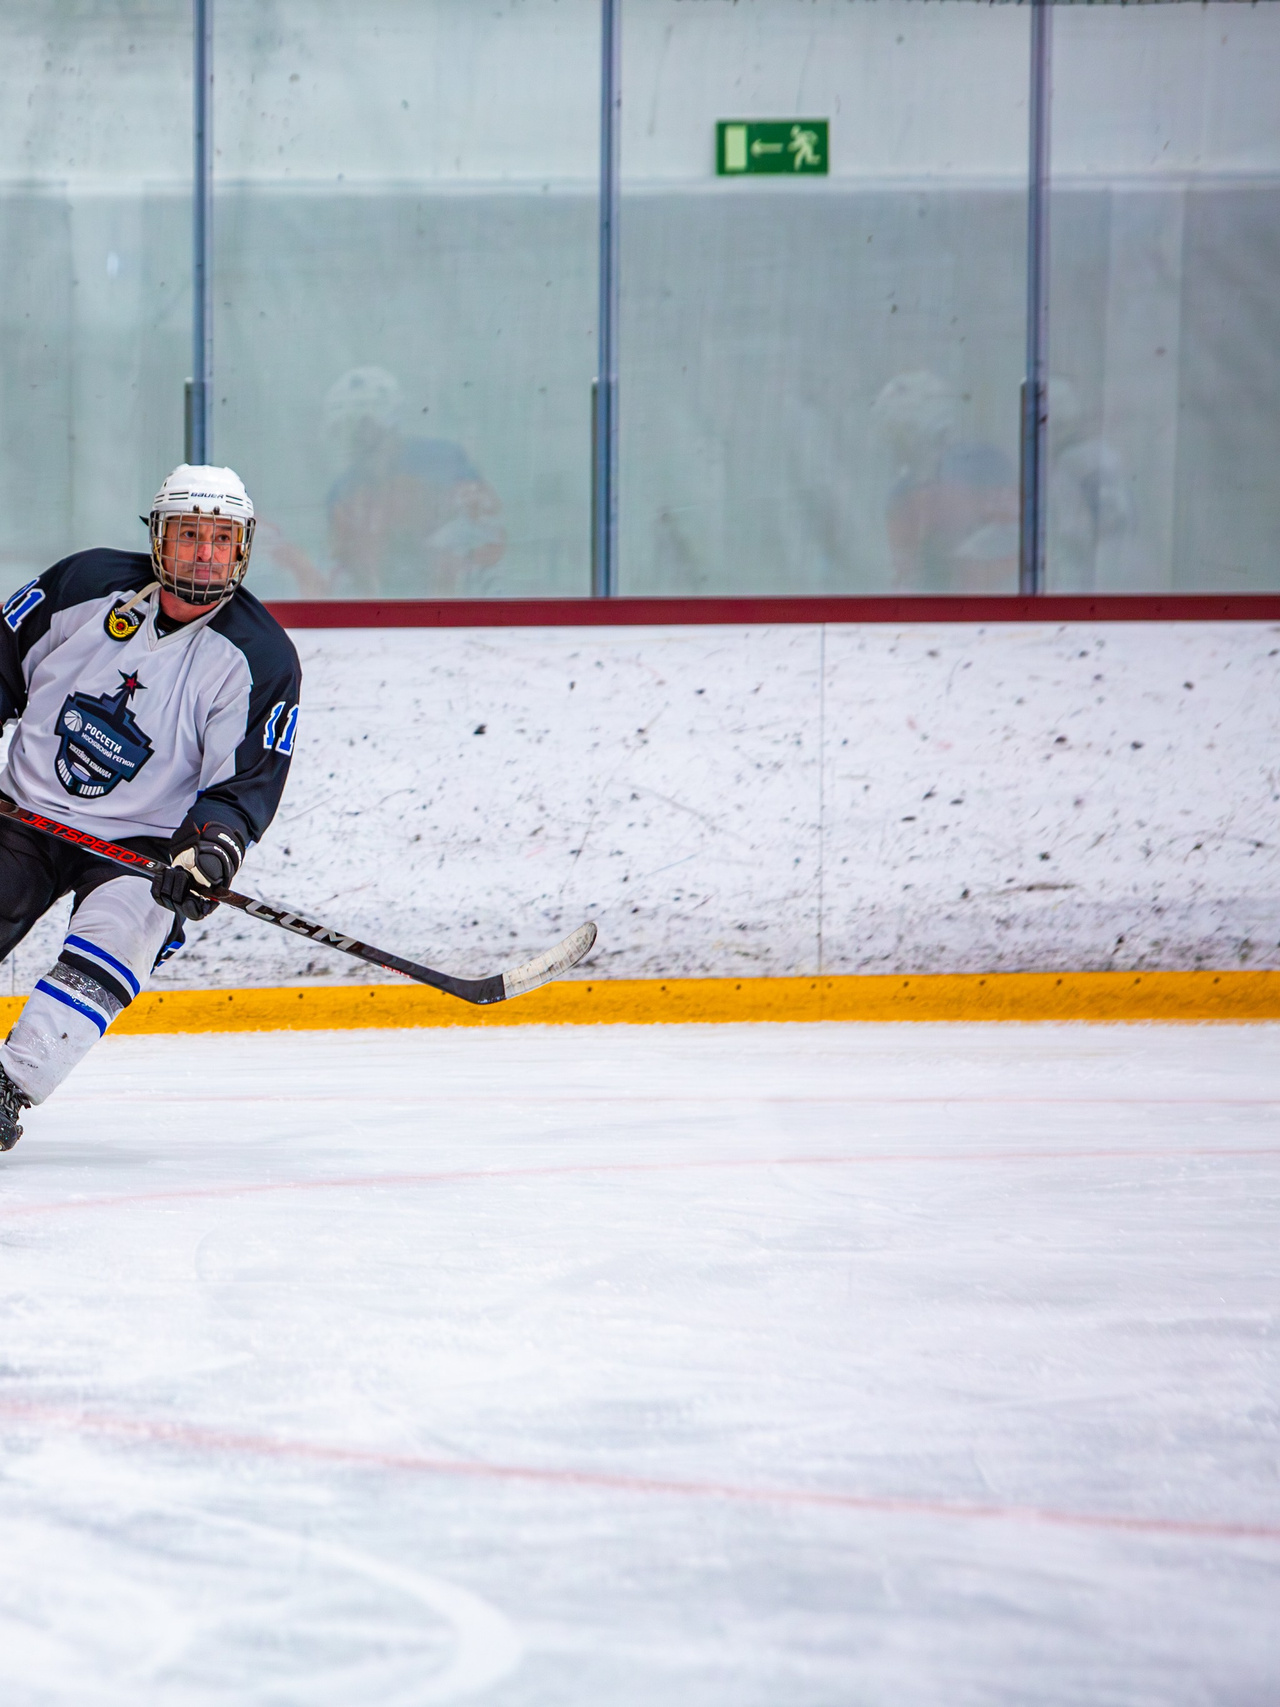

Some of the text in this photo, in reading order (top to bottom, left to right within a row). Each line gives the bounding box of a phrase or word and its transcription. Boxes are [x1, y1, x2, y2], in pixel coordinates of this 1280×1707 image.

[84, 722, 123, 754] РОССЕТИ
[263, 701, 300, 756] 11
[112, 753, 136, 769] РЕГИОН
[21, 814, 137, 863] JETSPEED
[245, 900, 357, 951] CCM
